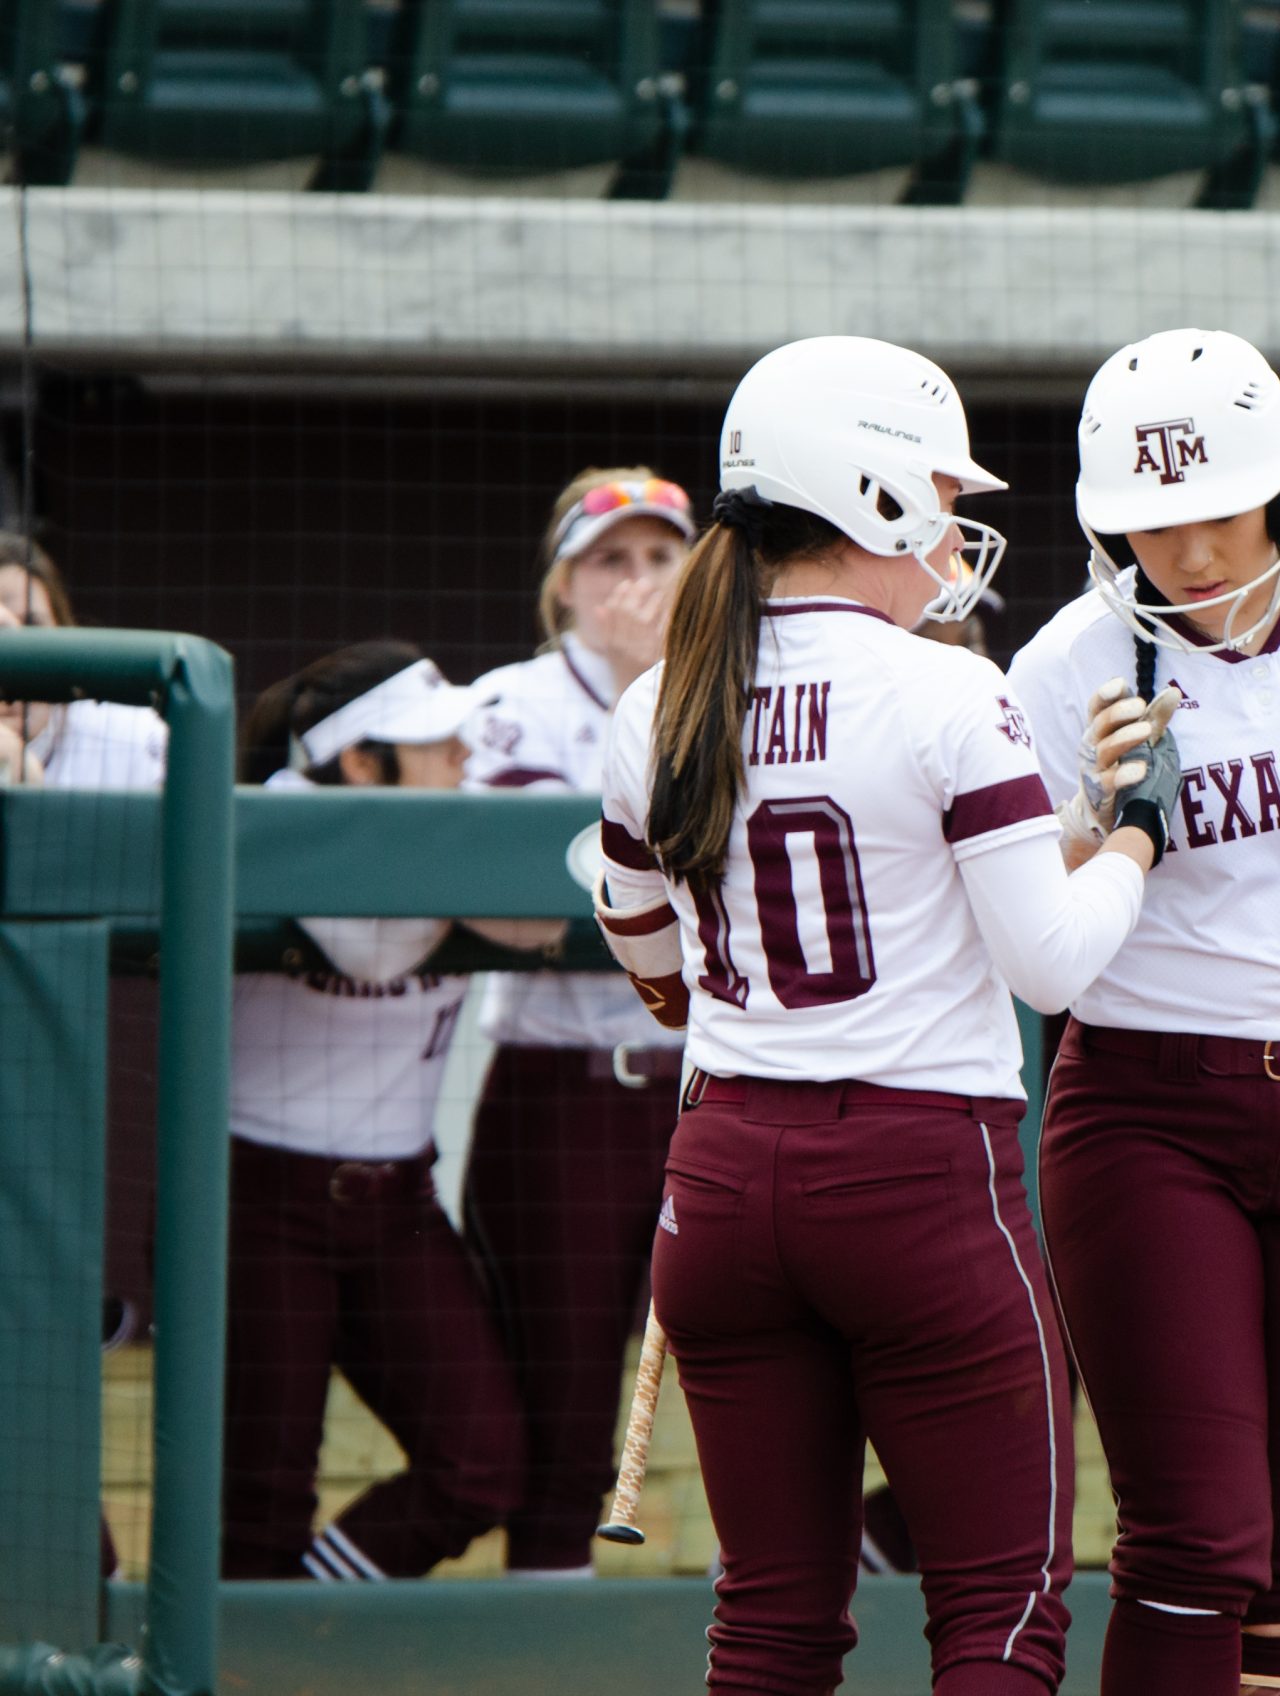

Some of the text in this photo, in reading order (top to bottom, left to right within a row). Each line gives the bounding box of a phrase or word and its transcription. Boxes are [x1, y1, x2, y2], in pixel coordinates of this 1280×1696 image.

[729, 430, 742, 454] 10
[857, 419, 922, 444] RAWLINGS
[746, 681, 831, 766] TAIN
